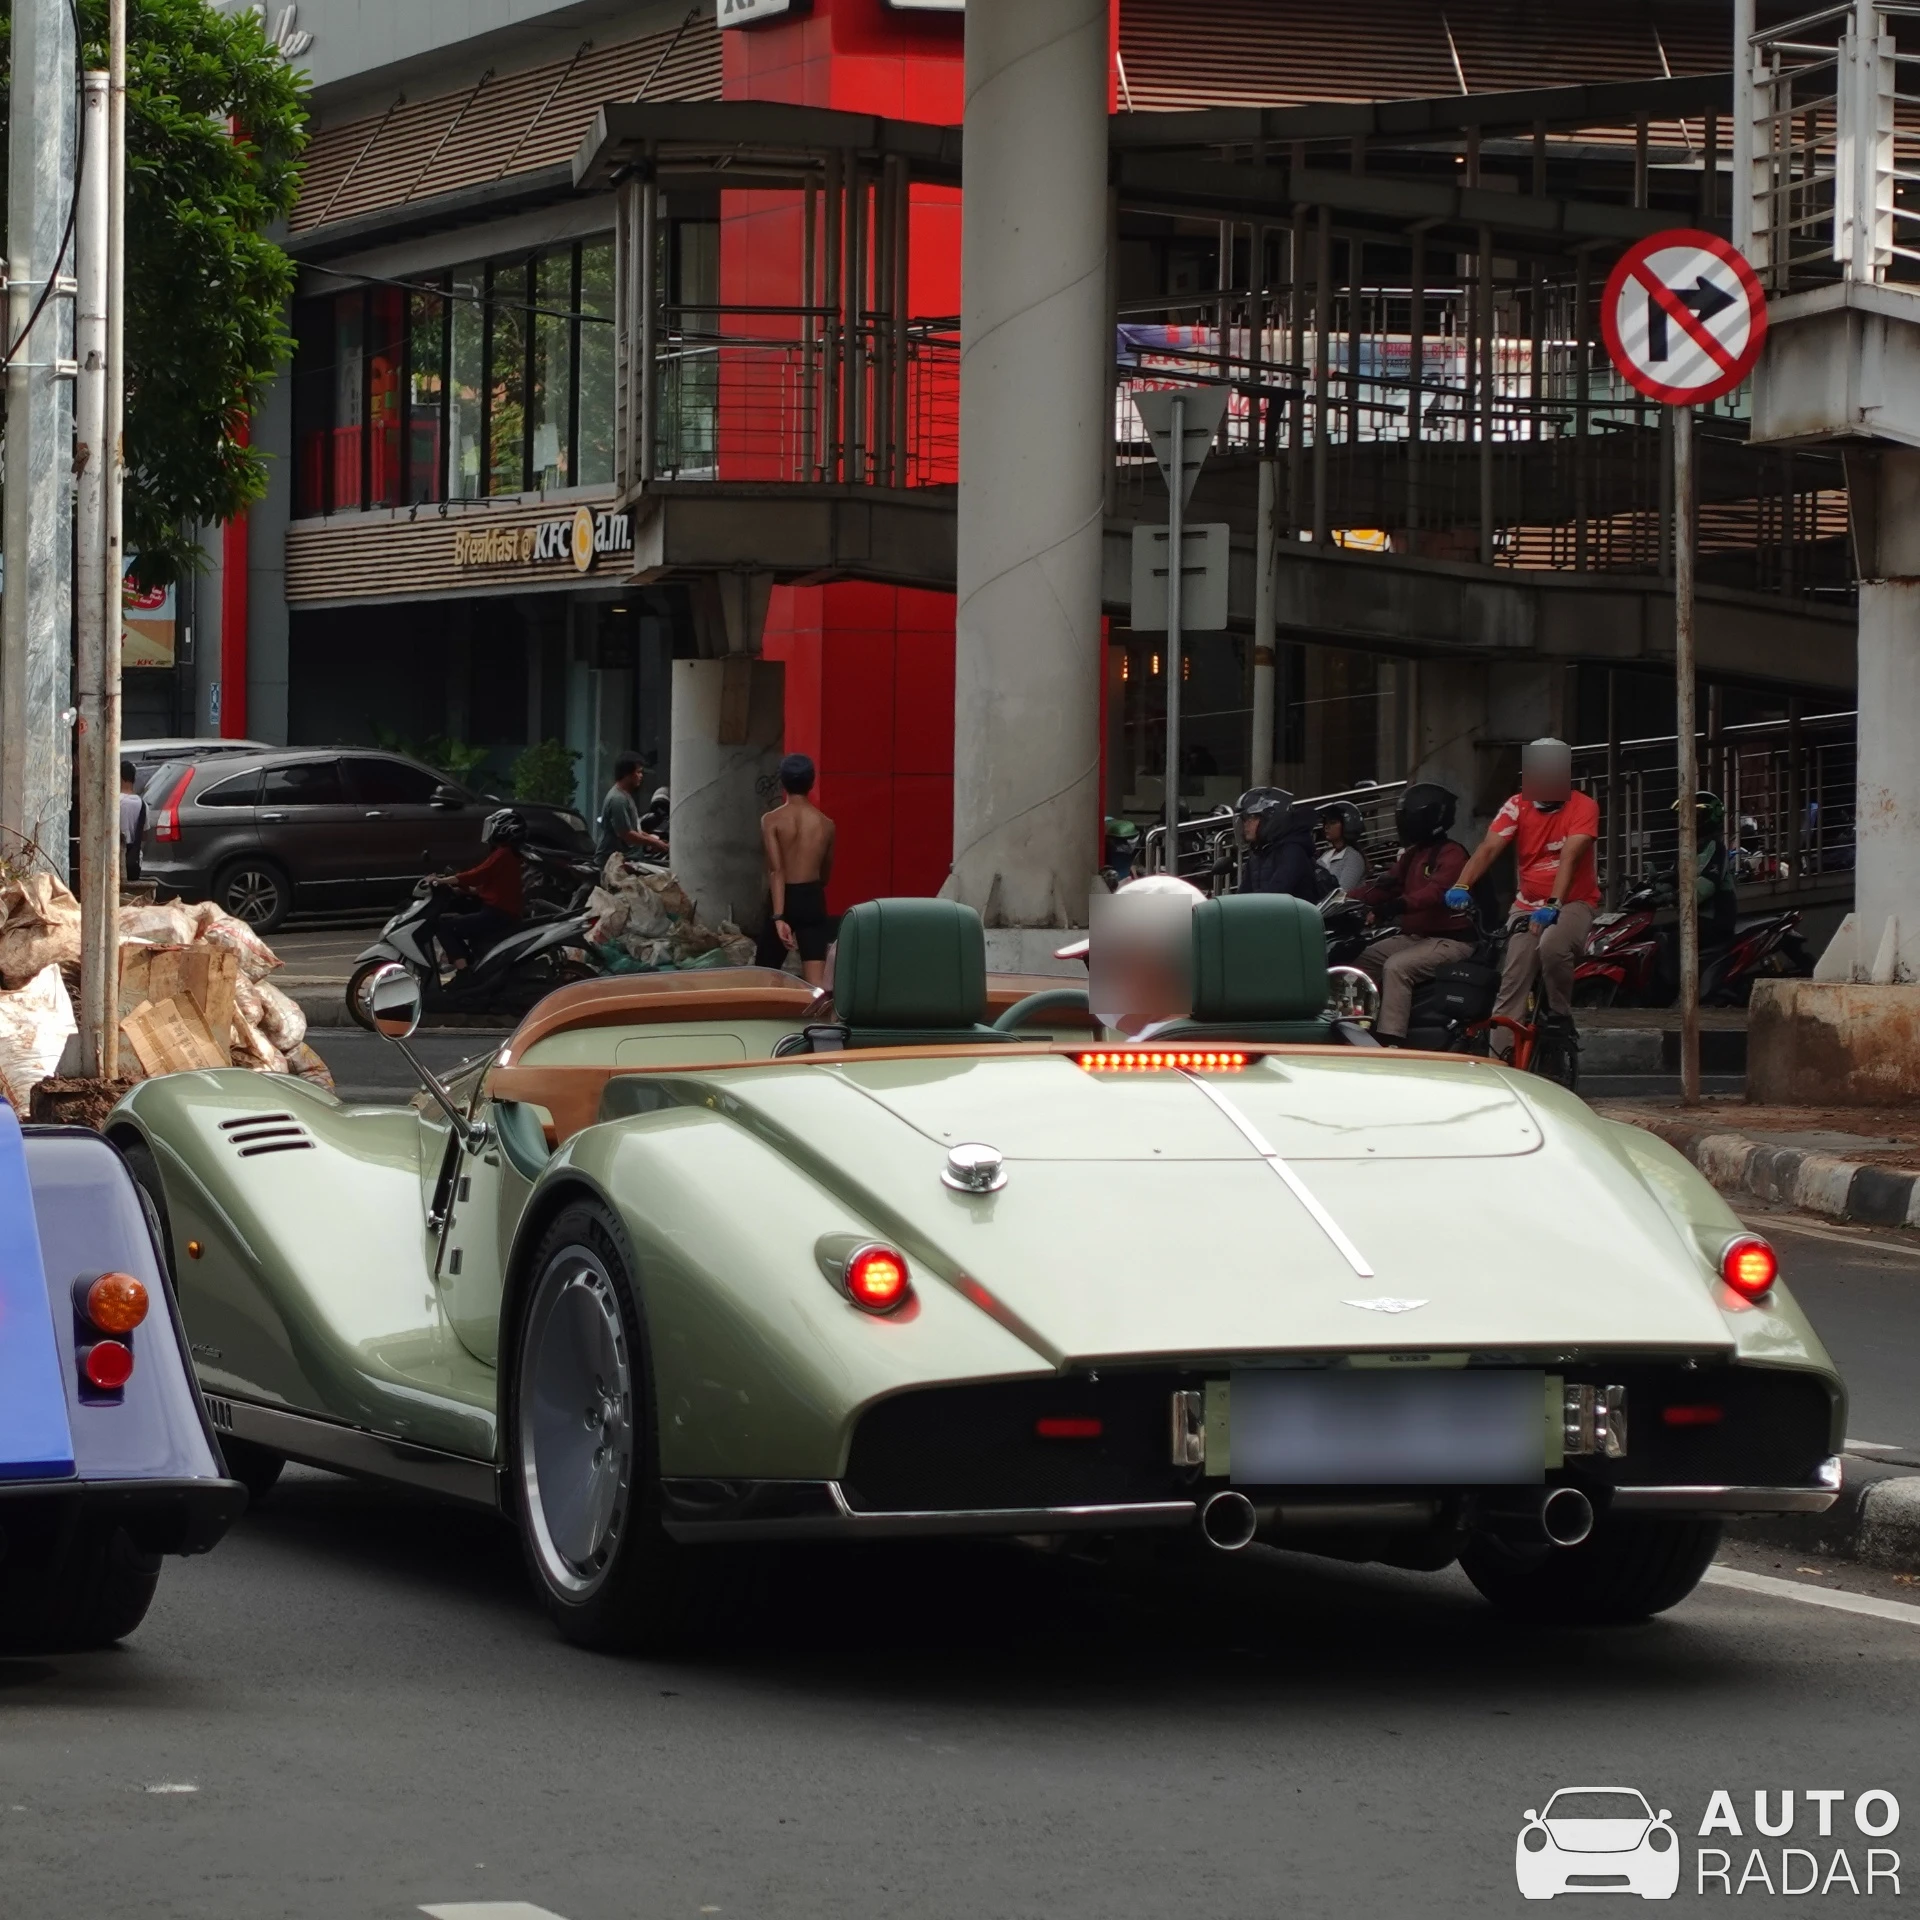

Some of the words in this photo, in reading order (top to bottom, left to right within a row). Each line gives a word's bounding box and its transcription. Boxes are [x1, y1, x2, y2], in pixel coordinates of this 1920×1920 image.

[454, 529, 519, 565] Breakfast
[521, 533, 532, 561] @
[533, 521, 572, 559] KFC
[594, 514, 632, 552] a.m.
